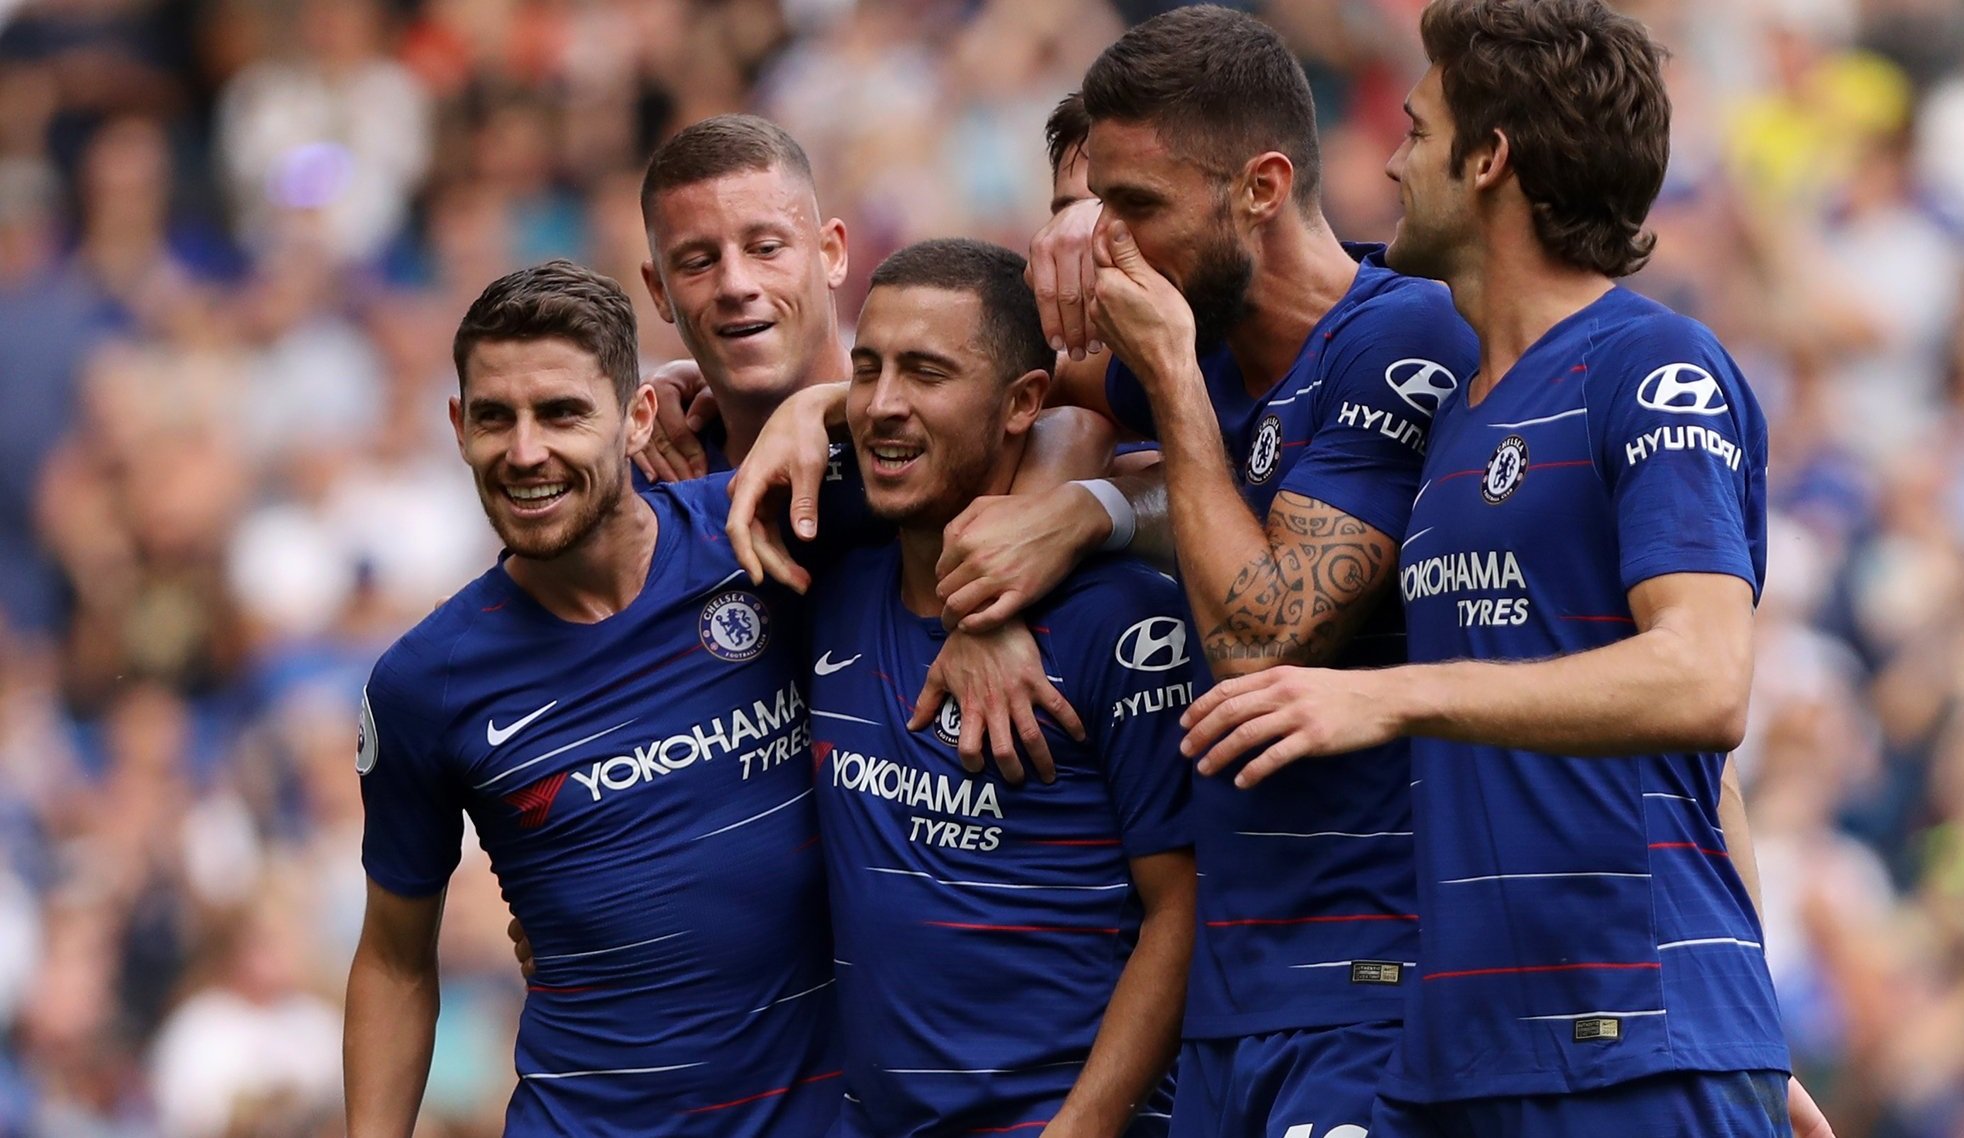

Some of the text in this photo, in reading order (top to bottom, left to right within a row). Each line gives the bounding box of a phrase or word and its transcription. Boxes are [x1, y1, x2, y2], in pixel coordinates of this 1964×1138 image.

[1337, 401, 1426, 456] HYUN
[1625, 425, 1742, 471] HYUNDAI
[1400, 551, 1527, 603] YOKOHAMA
[703, 593, 745, 621] CHELSEA
[1457, 597, 1529, 627] TYRES
[1111, 682, 1193, 727] HYUN
[571, 680, 806, 801] YOKOHAMA
[738, 719, 812, 781] TYRES
[937, 729, 958, 744] FOOTBAL
[831, 748, 1004, 820] YOKOHAMA
[909, 816, 1003, 852] TYRES
